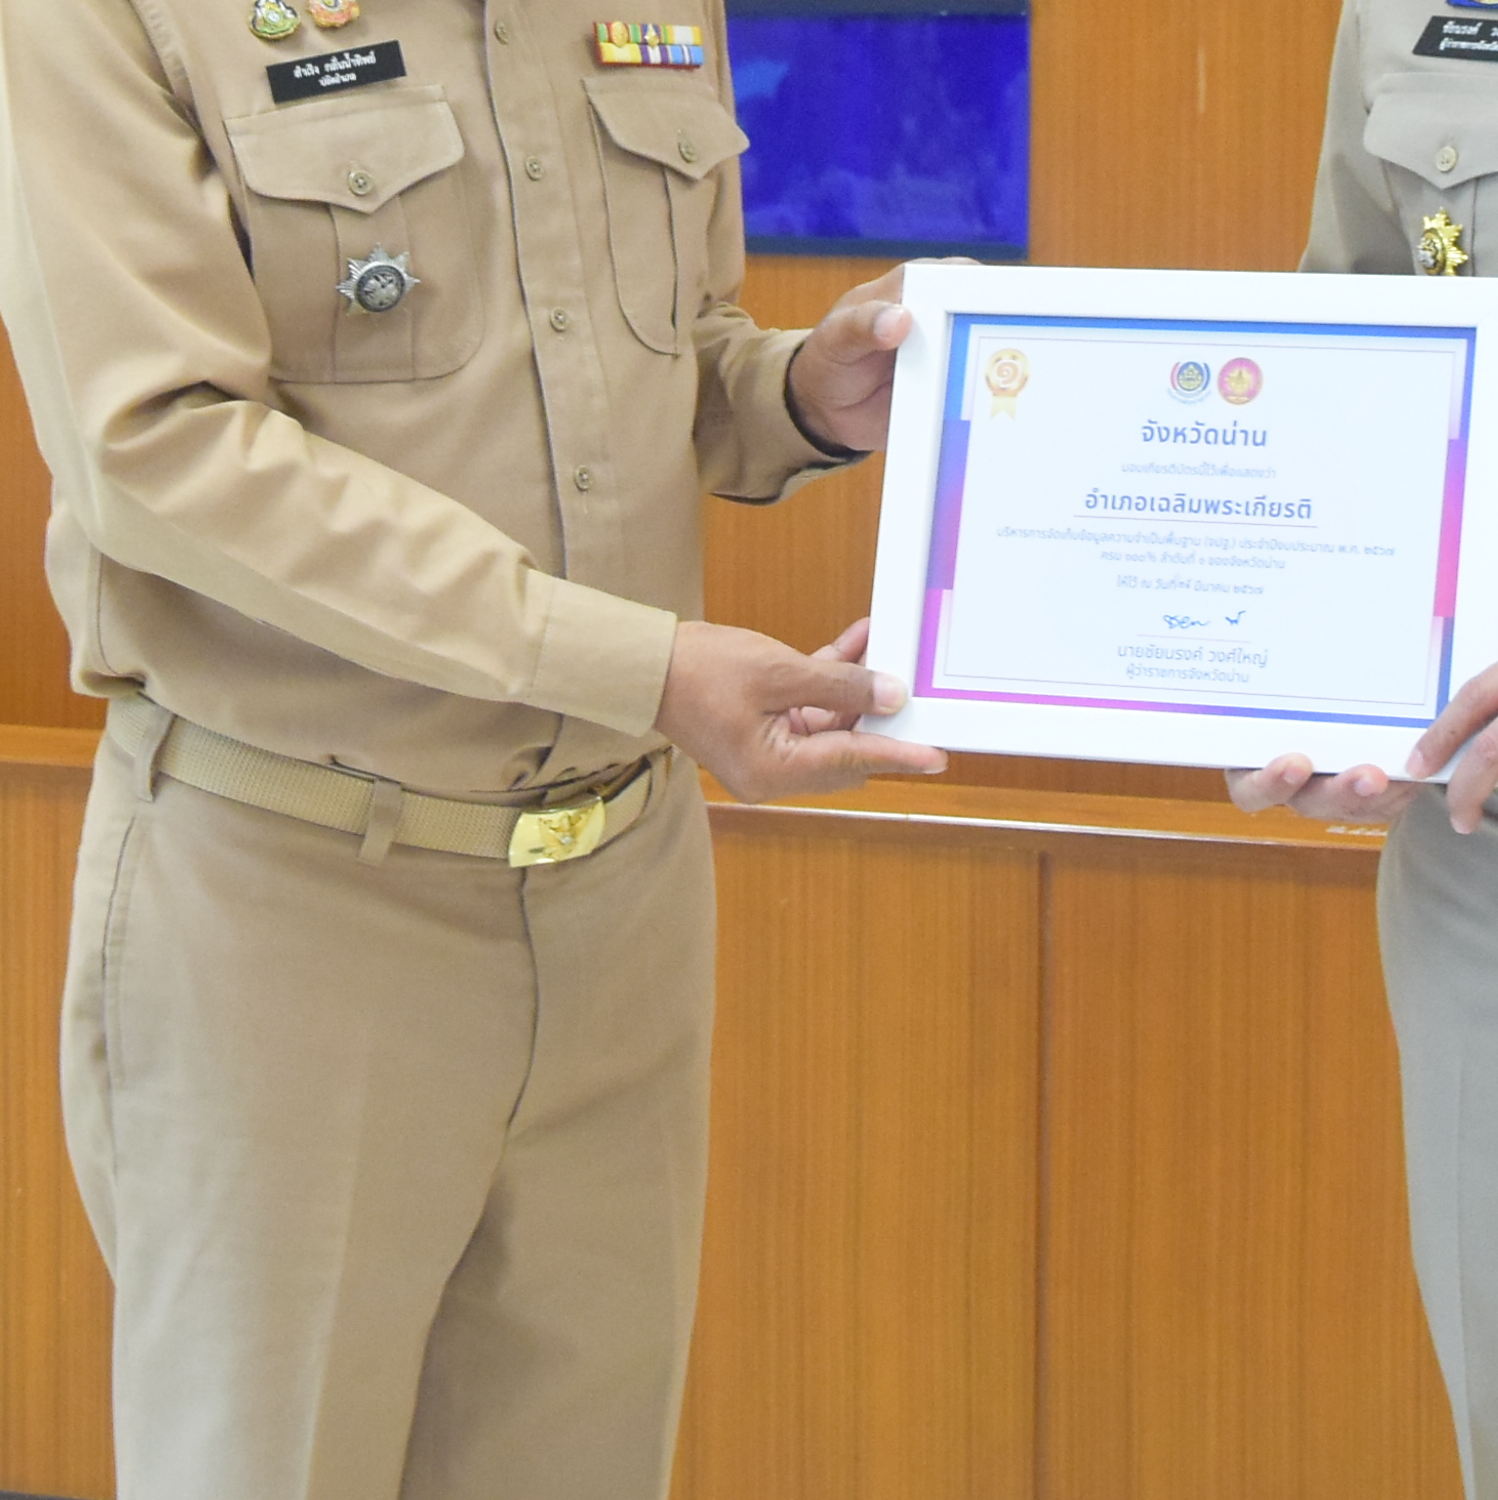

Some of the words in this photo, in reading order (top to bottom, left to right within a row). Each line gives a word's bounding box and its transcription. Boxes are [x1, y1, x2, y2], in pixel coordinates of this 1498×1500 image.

[1141, 419, 1268, 448] จังหวัดน่าน
[1085, 487, 1313, 520] อำเภอเฉลิมพระเกียรติ
[1117, 644, 1204, 661] นายชัยนรงค์
[1209, 647, 1269, 669] วงศ์ใหญ่
